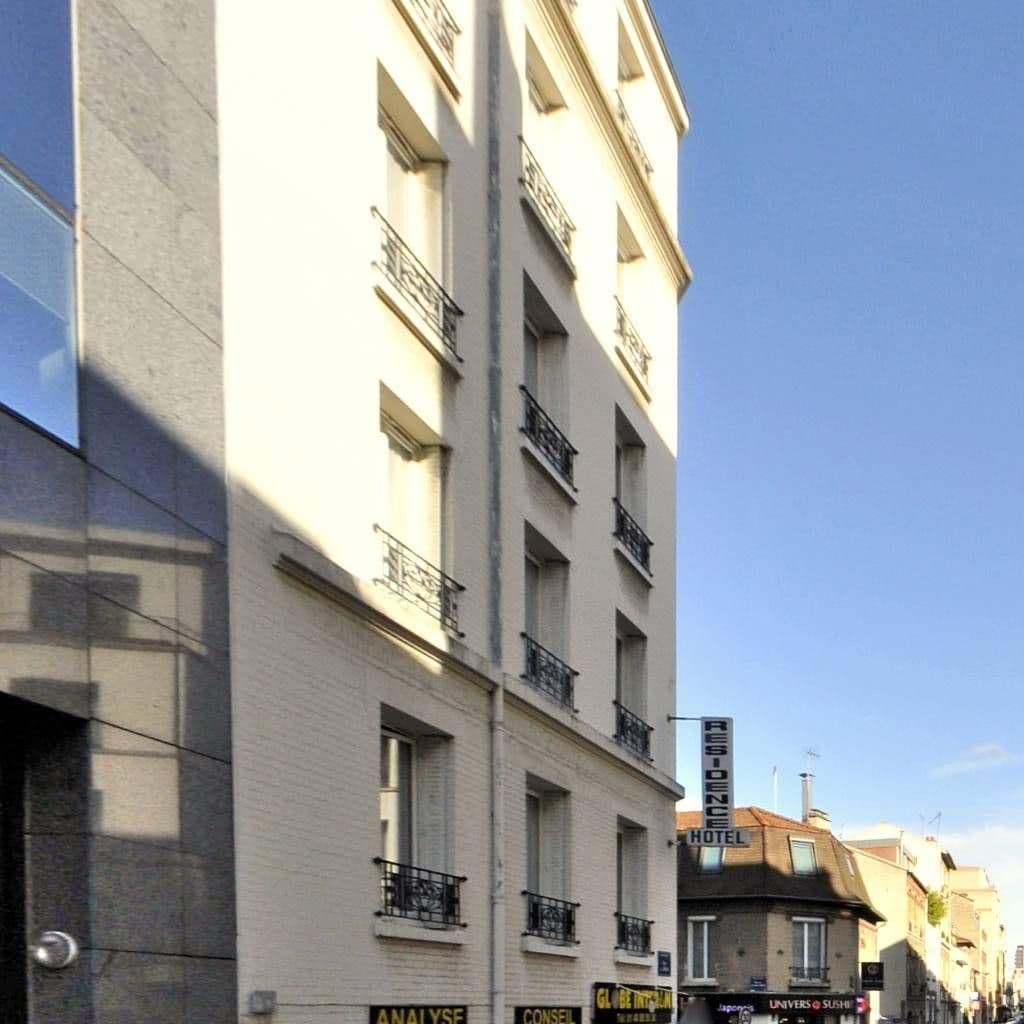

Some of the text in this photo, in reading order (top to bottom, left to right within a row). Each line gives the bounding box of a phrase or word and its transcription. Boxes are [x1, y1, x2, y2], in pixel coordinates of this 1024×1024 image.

[705, 721, 728, 828] RESIDENCE
[690, 831, 745, 844] HOTEL
[596, 988, 632, 1009] GLBE
[770, 999, 851, 1009] UNIVERS SUSHI
